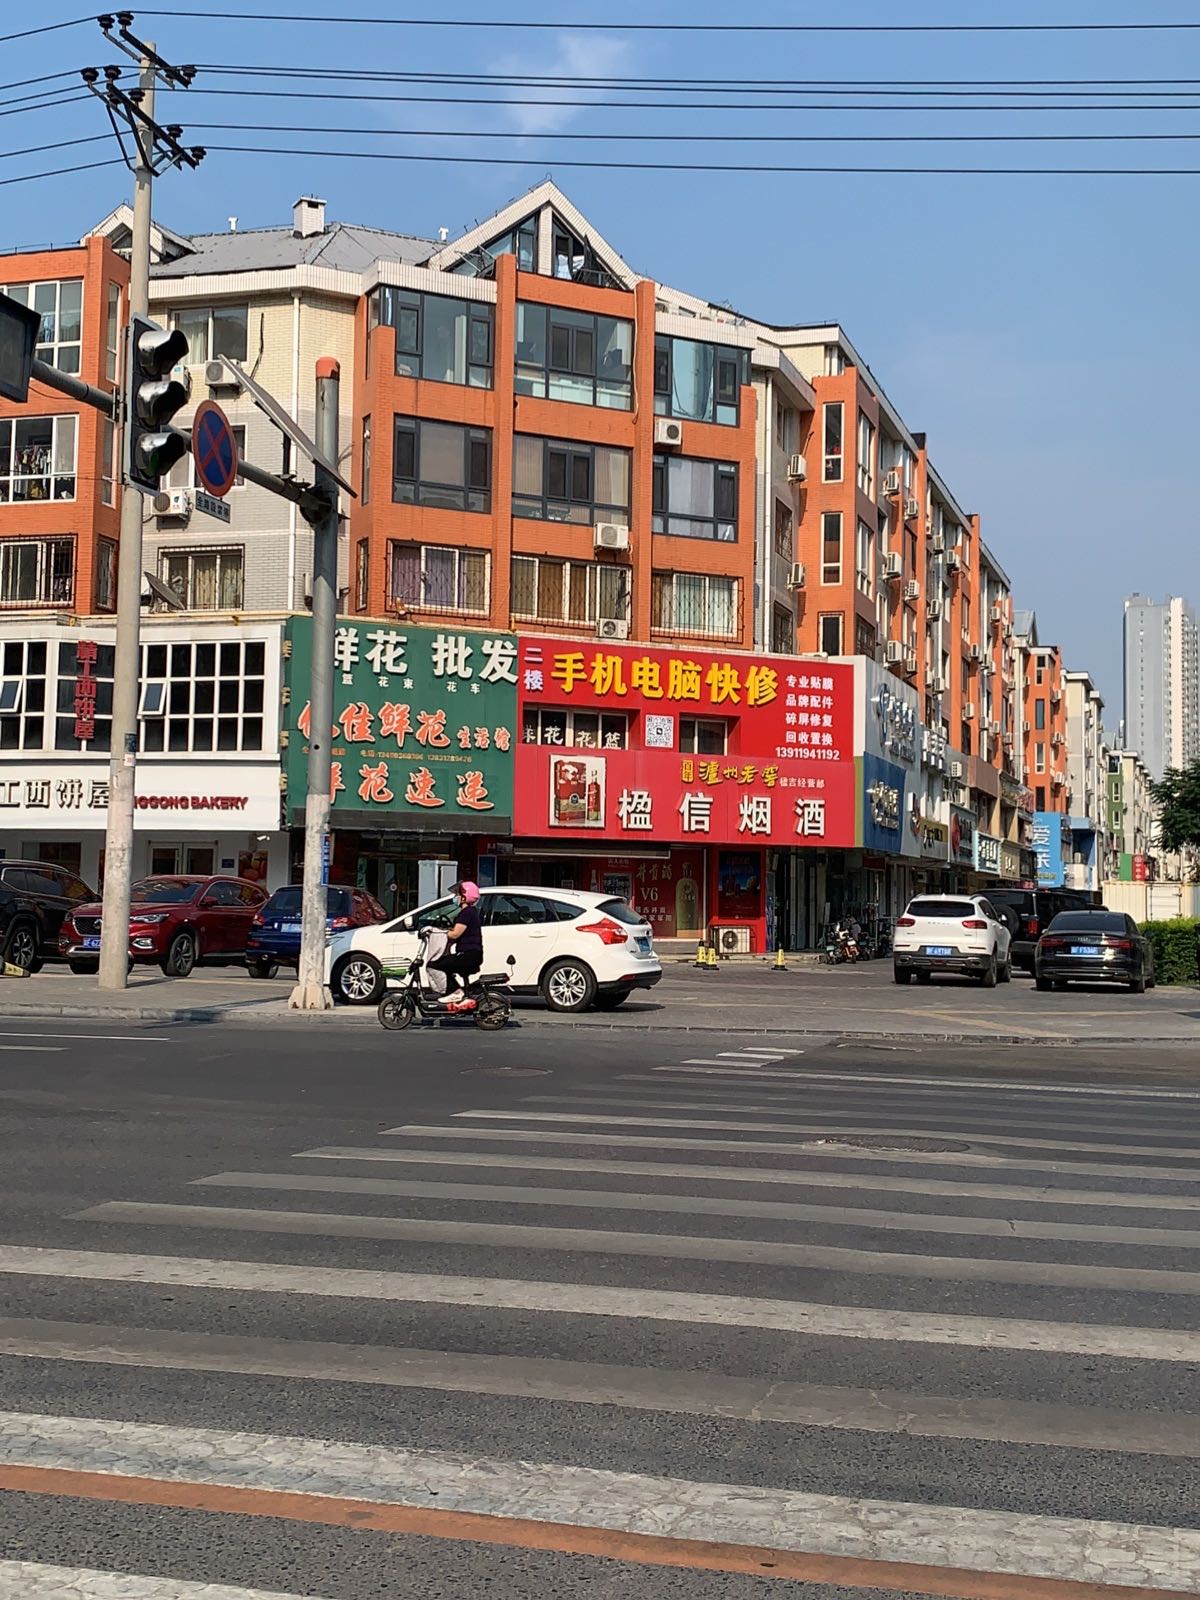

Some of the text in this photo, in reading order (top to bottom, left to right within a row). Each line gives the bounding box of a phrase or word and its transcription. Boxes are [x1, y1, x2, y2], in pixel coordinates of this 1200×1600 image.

[431, 633, 519, 684] 批发
[523, 646, 544, 692] 二楼
[551, 651, 780, 707] 手机电脑快修
[785, 675, 834, 691] 专业贴膜
[785, 694, 834, 710] 品牌配件
[785, 712, 833, 728] 碎屏修复
[785, 730, 833, 747] 回收置换
[775, 746, 841, 761] 13911941192
[699, 760, 780, 788] 泸州老窖
[191, 796, 249, 811] BAKERY
[618, 787, 827, 837] 楹信烟酒
[640, 886, 659, 901] V6
